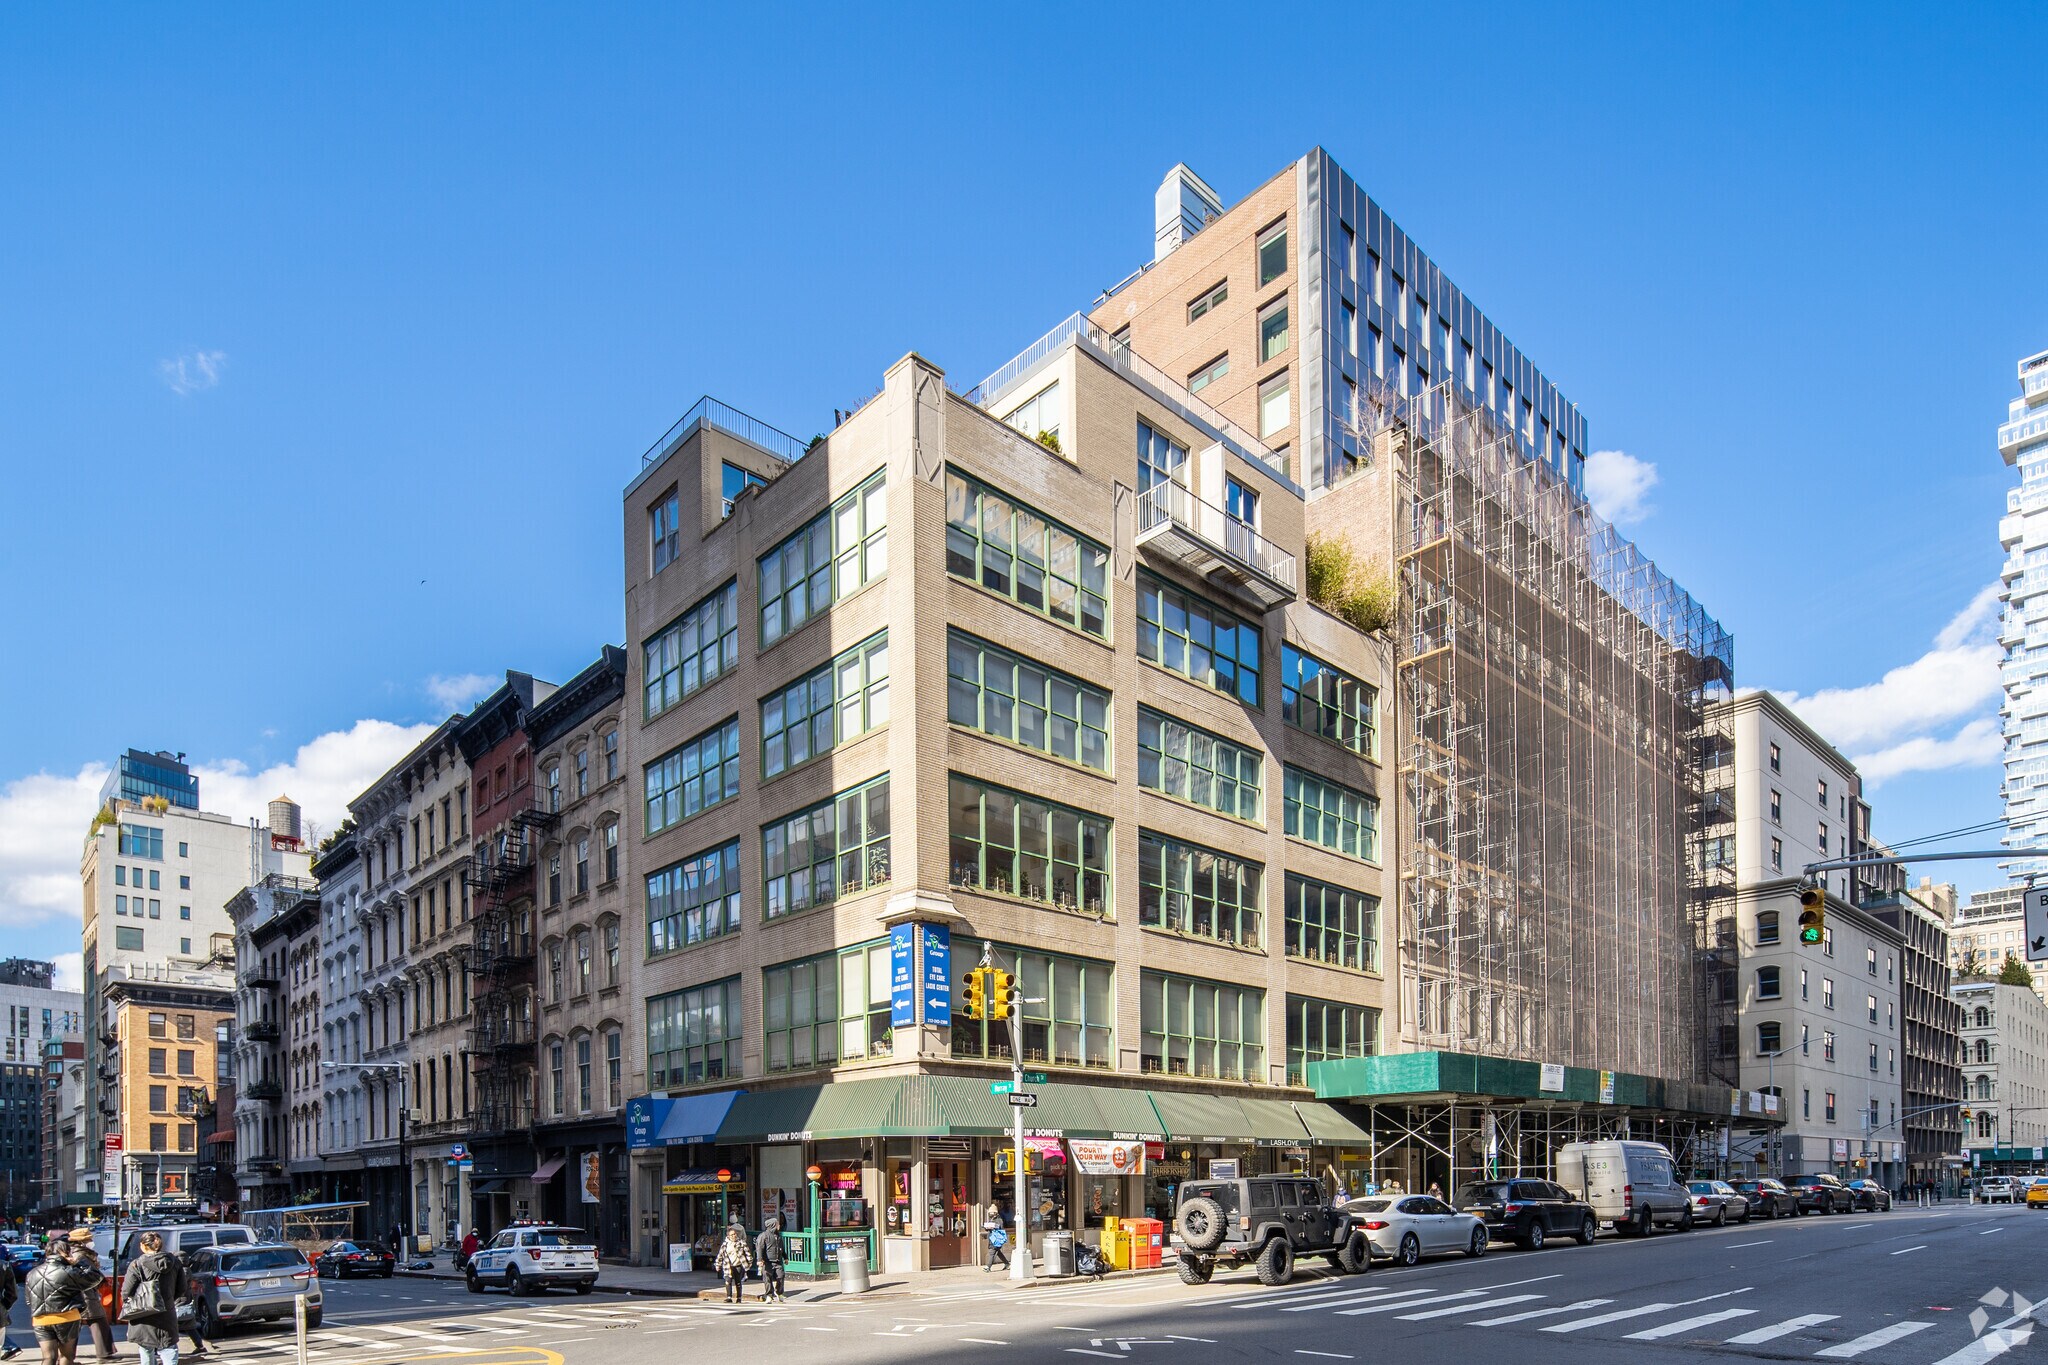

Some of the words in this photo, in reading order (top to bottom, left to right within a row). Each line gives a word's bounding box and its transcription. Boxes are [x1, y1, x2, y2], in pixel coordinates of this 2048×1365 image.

[932, 966, 942, 974] TOTAL
[1025, 1074, 1040, 1082] Church
[768, 1133, 789, 1141] DUNKIN'
[791, 1131, 812, 1139] DONUTS
[1004, 1128, 1033, 1137] DUIN'
[1036, 1129, 1063, 1137] DONUTS
[831, 1181, 855, 1189] DONUTS
[481, 1257, 492, 1268] NYPD
